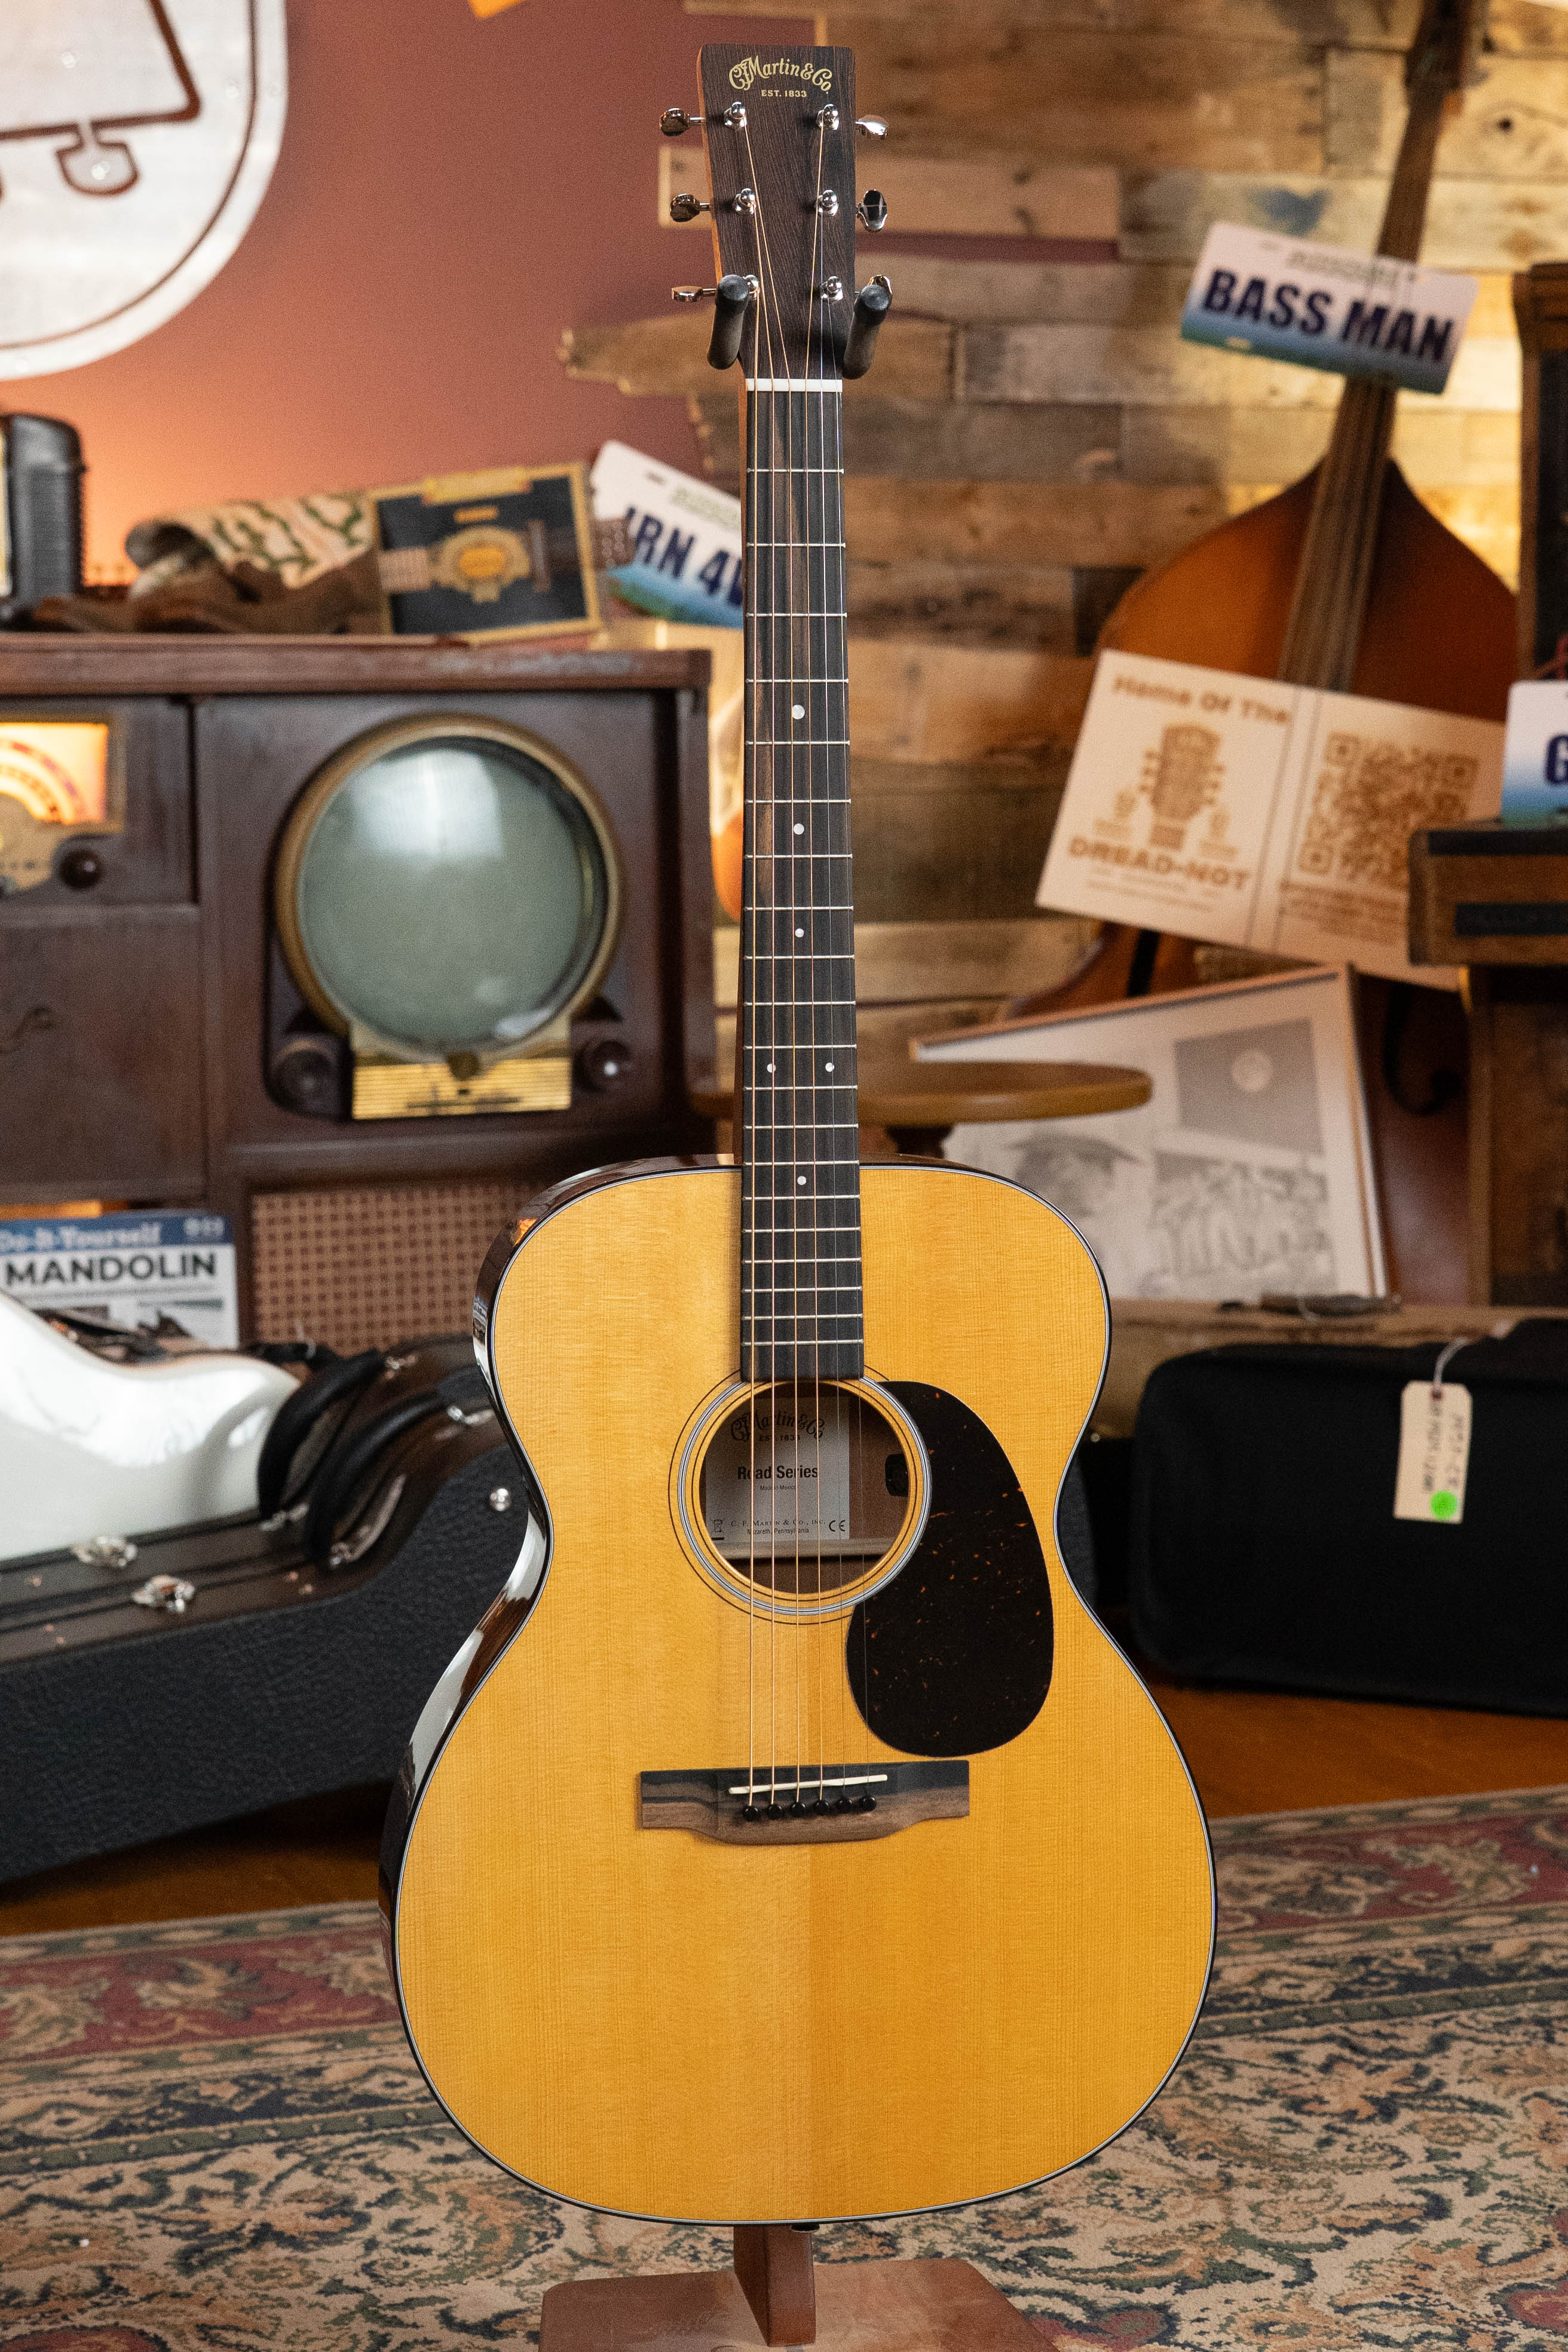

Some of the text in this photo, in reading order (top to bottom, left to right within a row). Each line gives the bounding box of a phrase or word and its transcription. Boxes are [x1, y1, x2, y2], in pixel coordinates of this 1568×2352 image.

[1202, 266, 1333, 337] BASS
[1340, 299, 1454, 362] MAN
[5, 1252, 216, 1285] MANDOLIN
